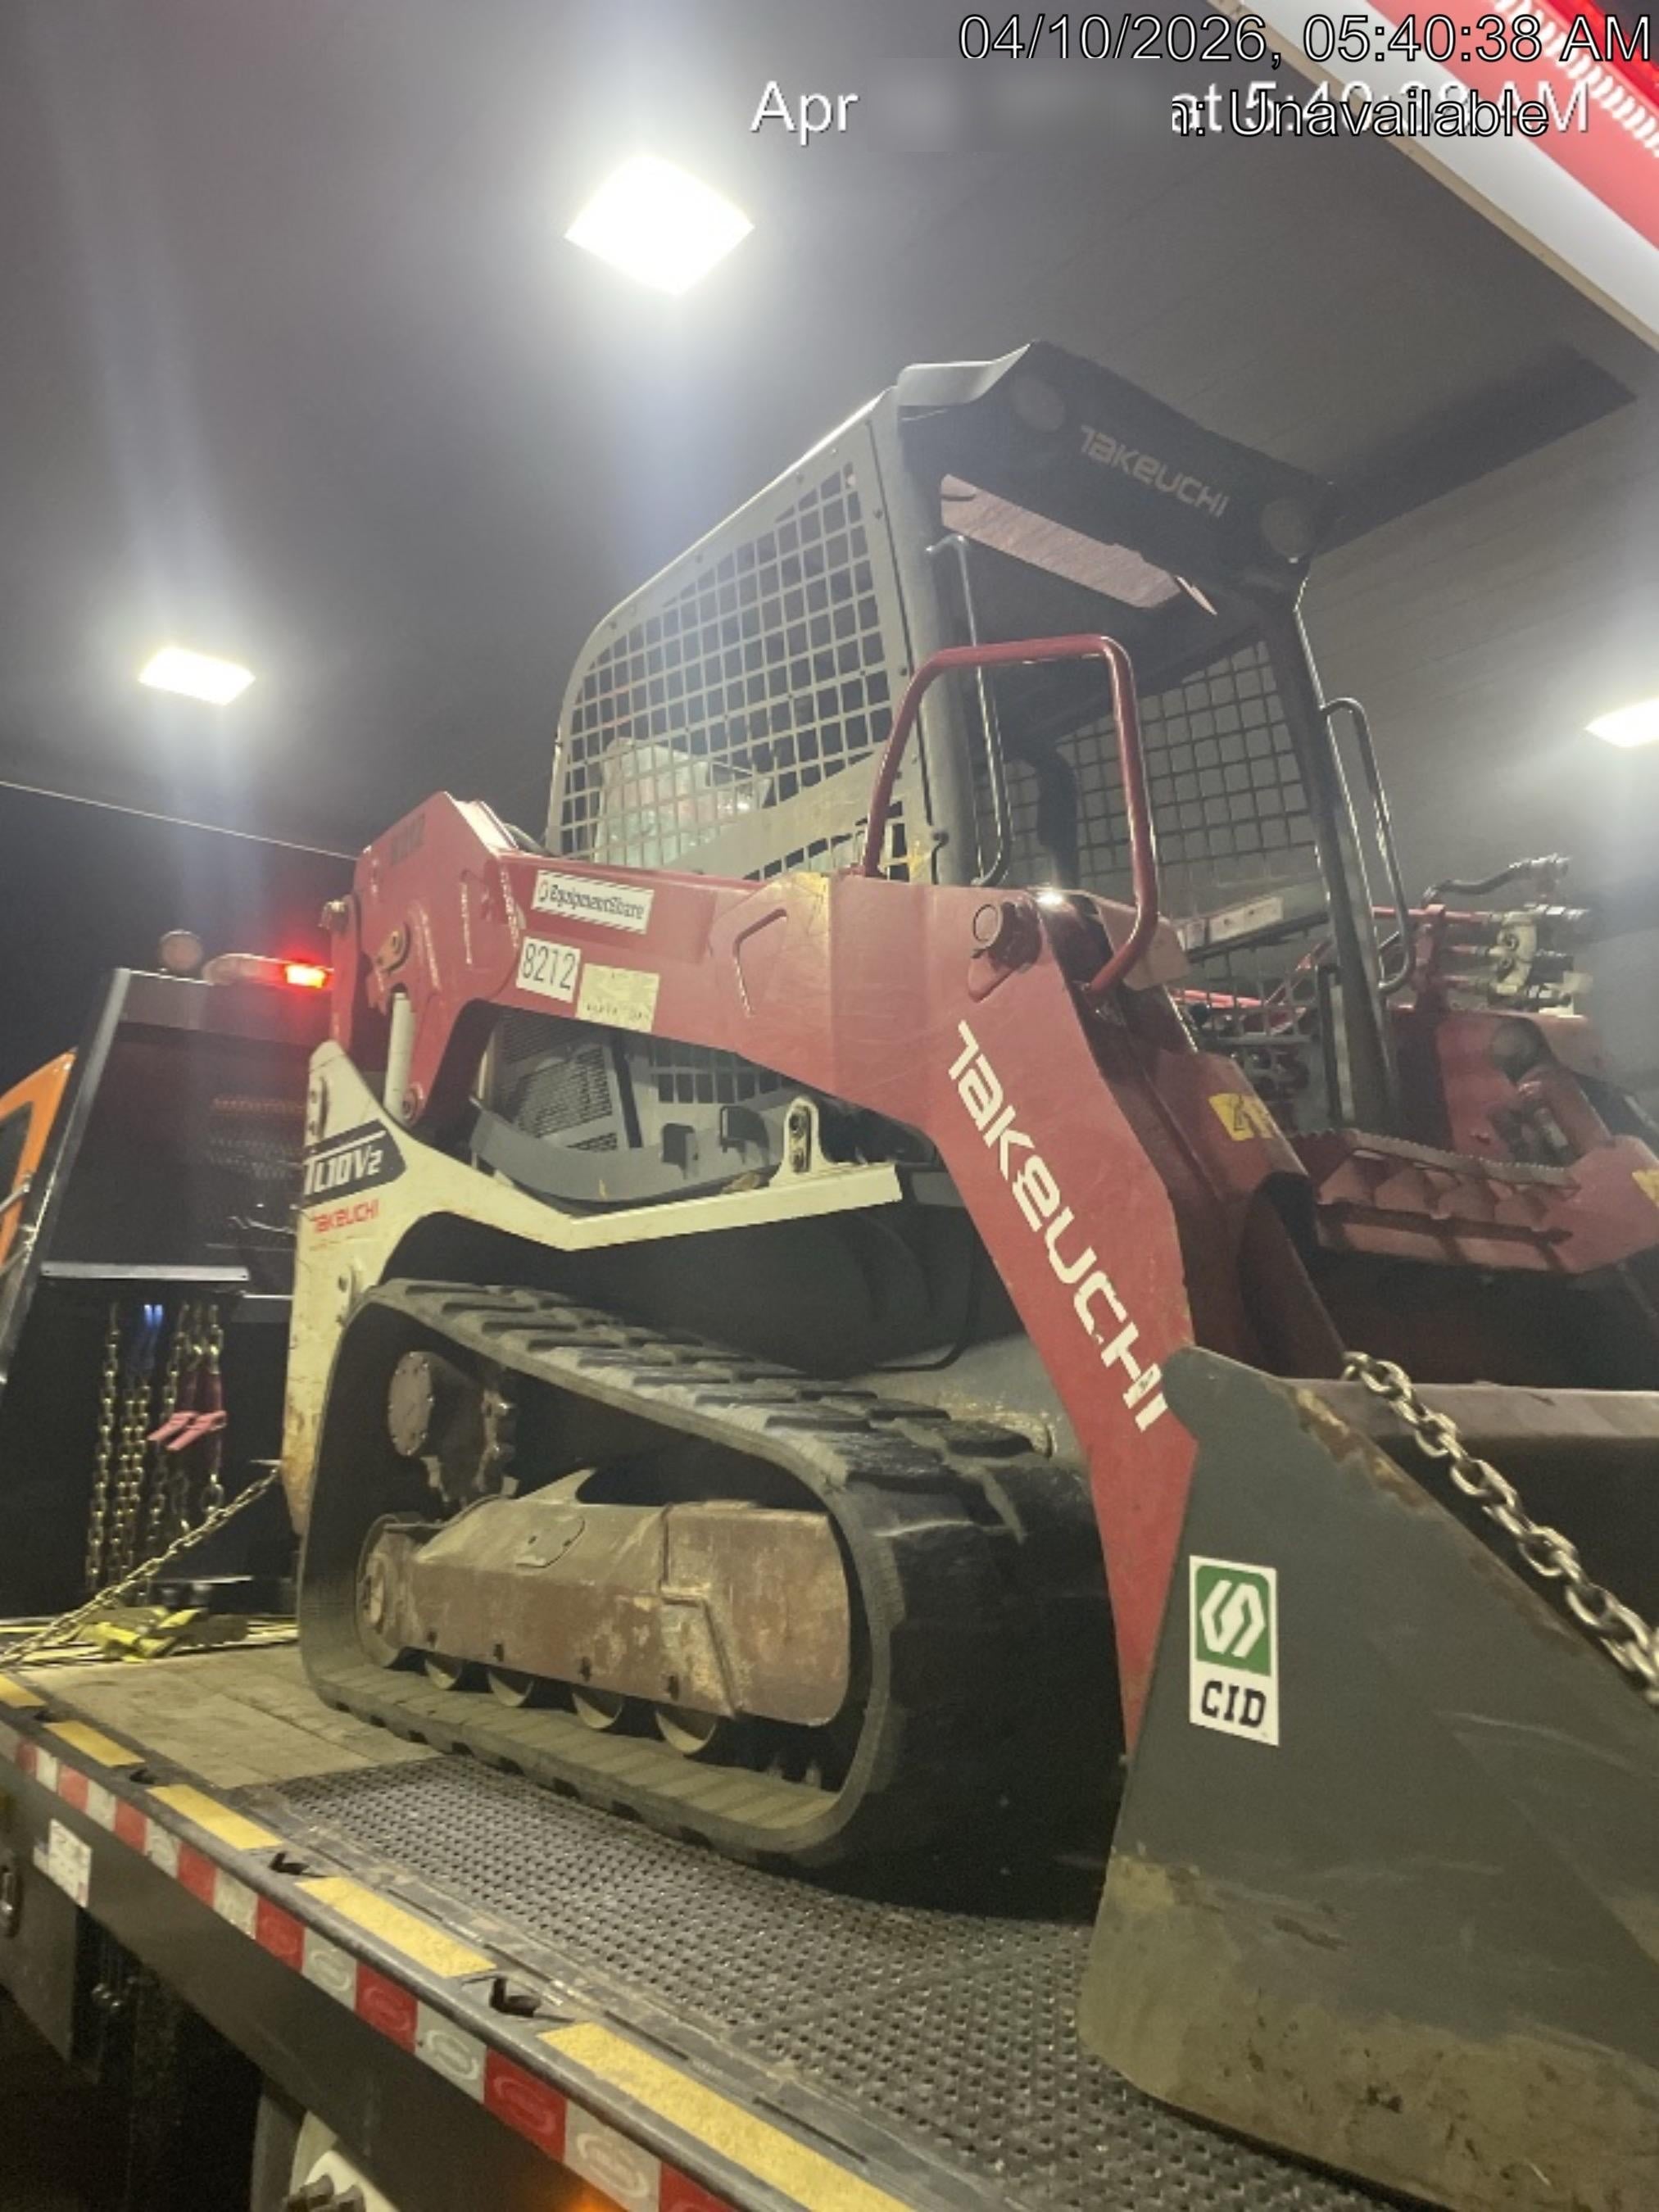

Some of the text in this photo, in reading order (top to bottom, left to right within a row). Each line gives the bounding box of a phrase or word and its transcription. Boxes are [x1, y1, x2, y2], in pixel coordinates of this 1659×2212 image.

[1081, 424, 1230, 519] TAKEUCHI
[522, 943, 576, 990] 8212
[948, 1019, 1168, 1433] TAKEUCHI
[1201, 1679, 1267, 1728] CID
